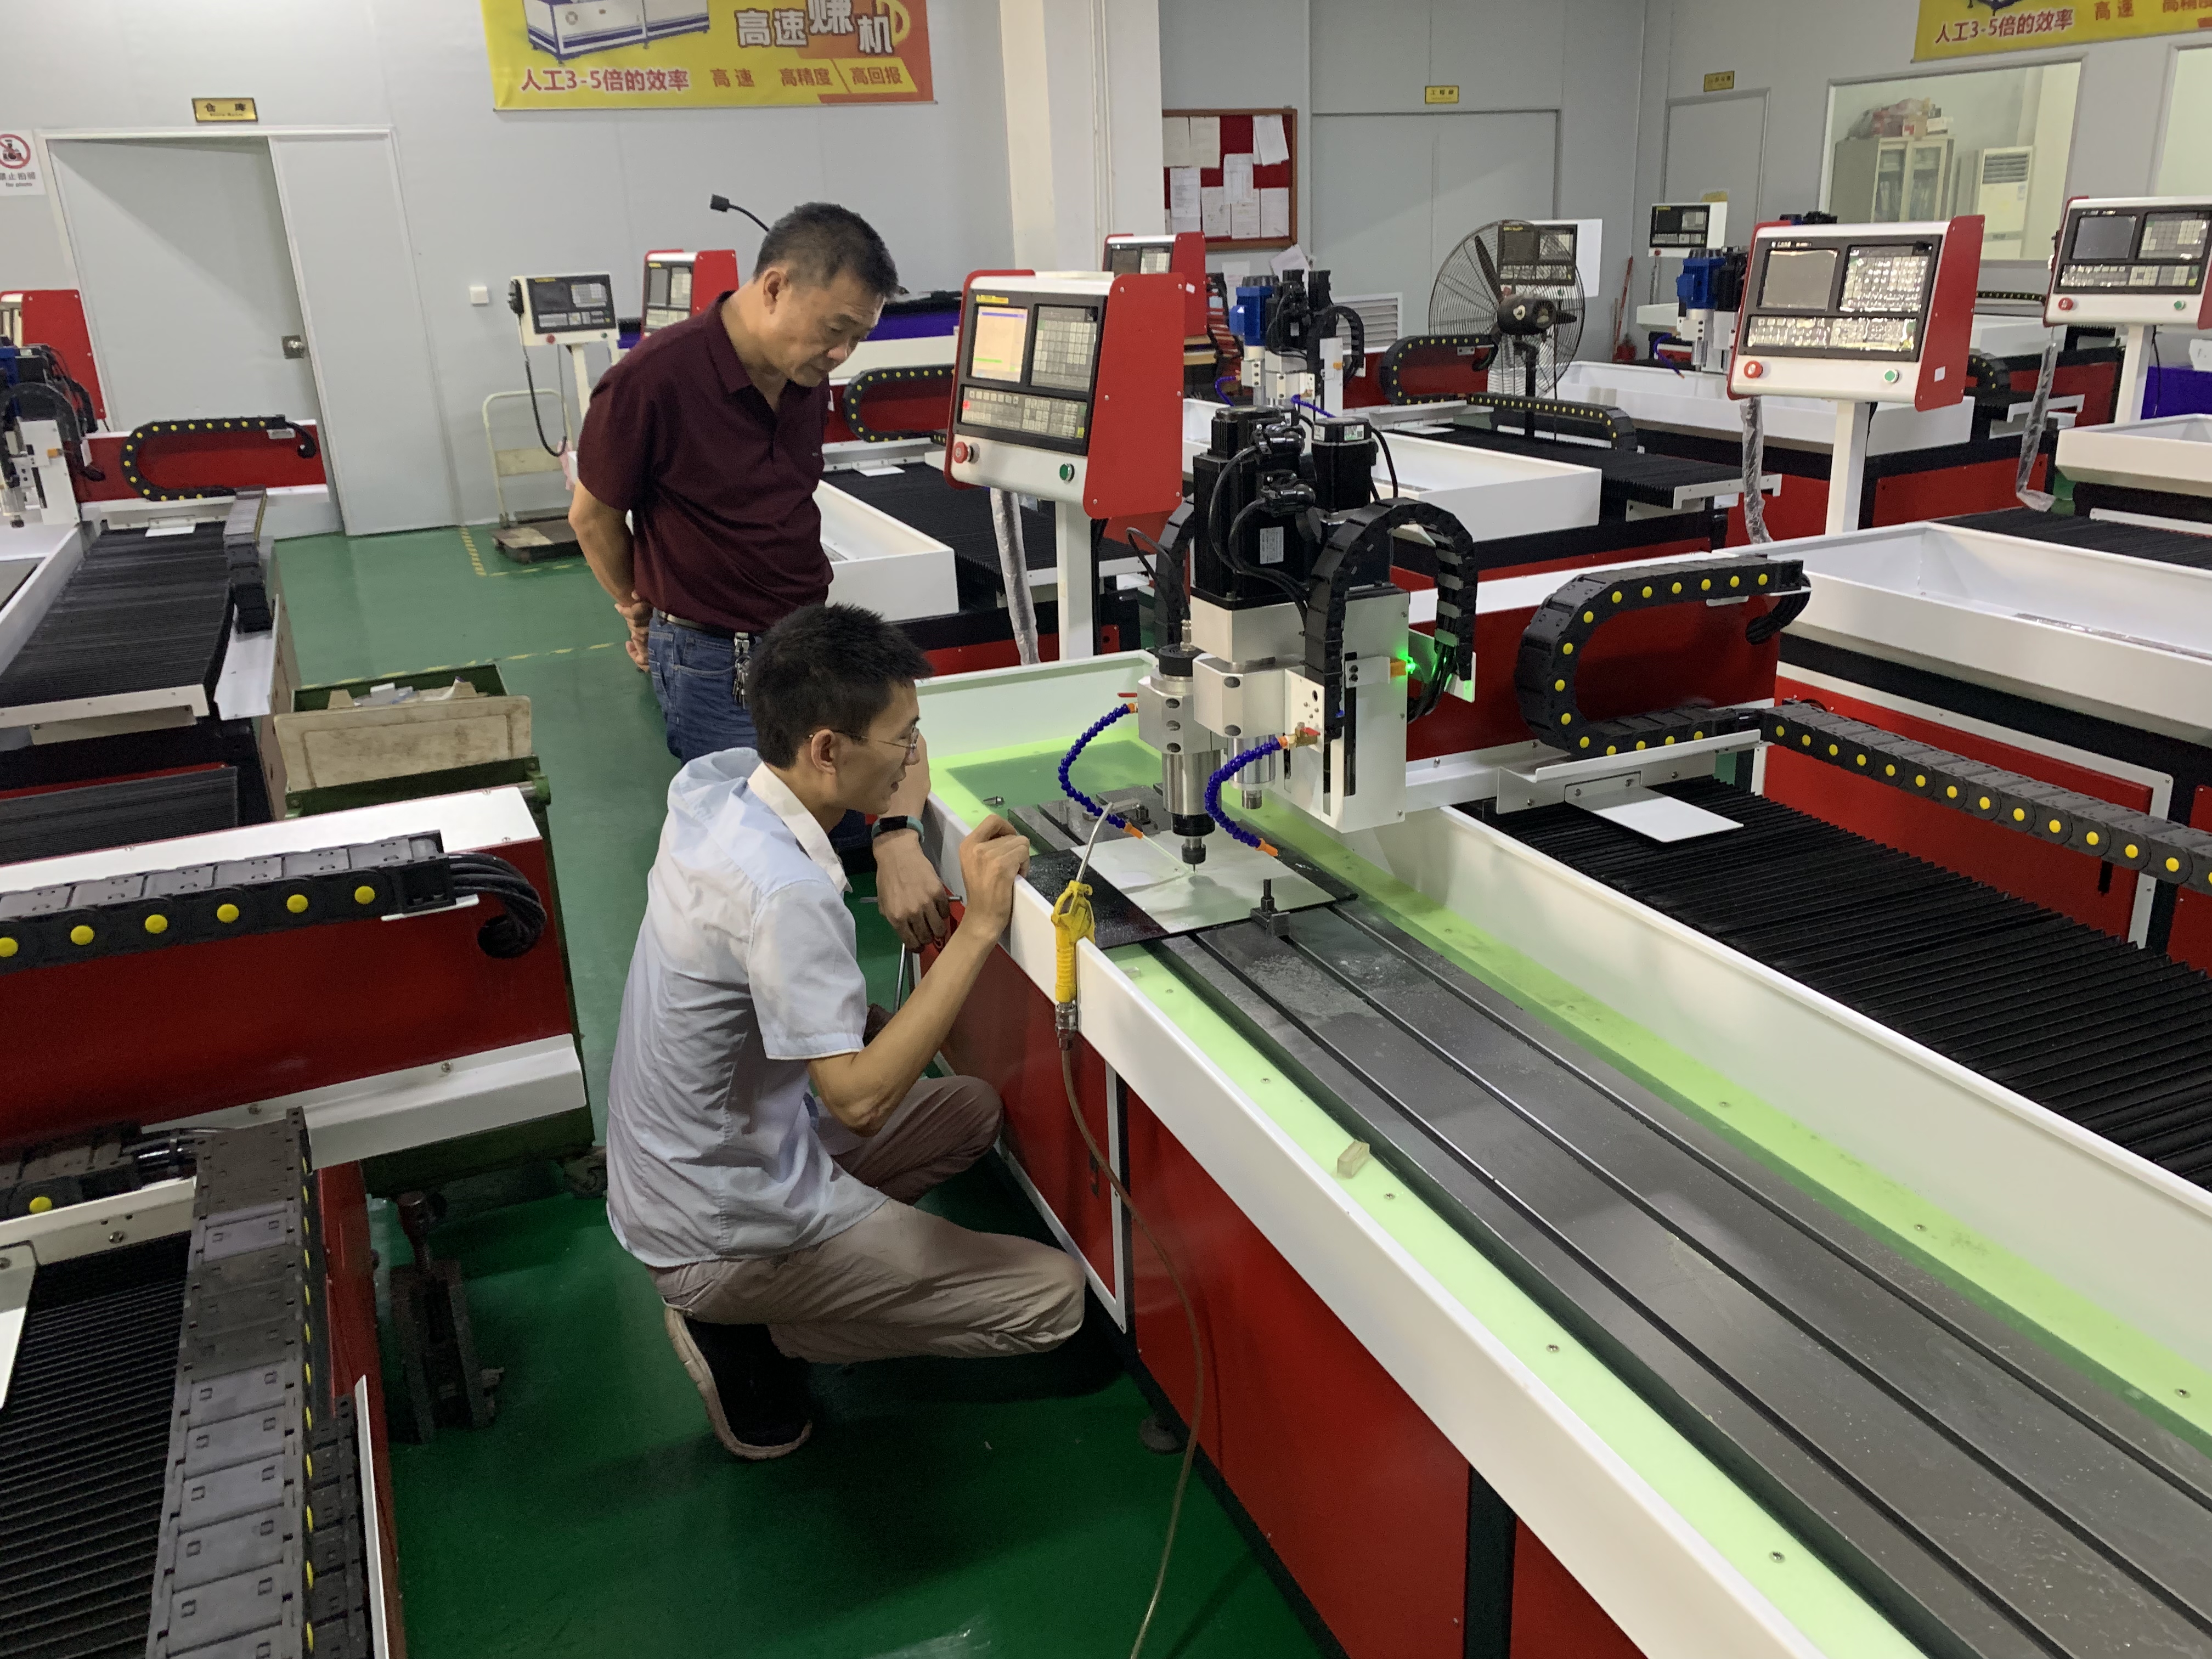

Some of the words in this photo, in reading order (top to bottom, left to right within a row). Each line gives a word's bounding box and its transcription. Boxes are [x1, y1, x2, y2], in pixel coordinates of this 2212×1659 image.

[521, 69, 689, 92] 人工3-5倍的效率
[778, 67, 833, 87] 高精度
[849, 66, 903, 85] 高回报
